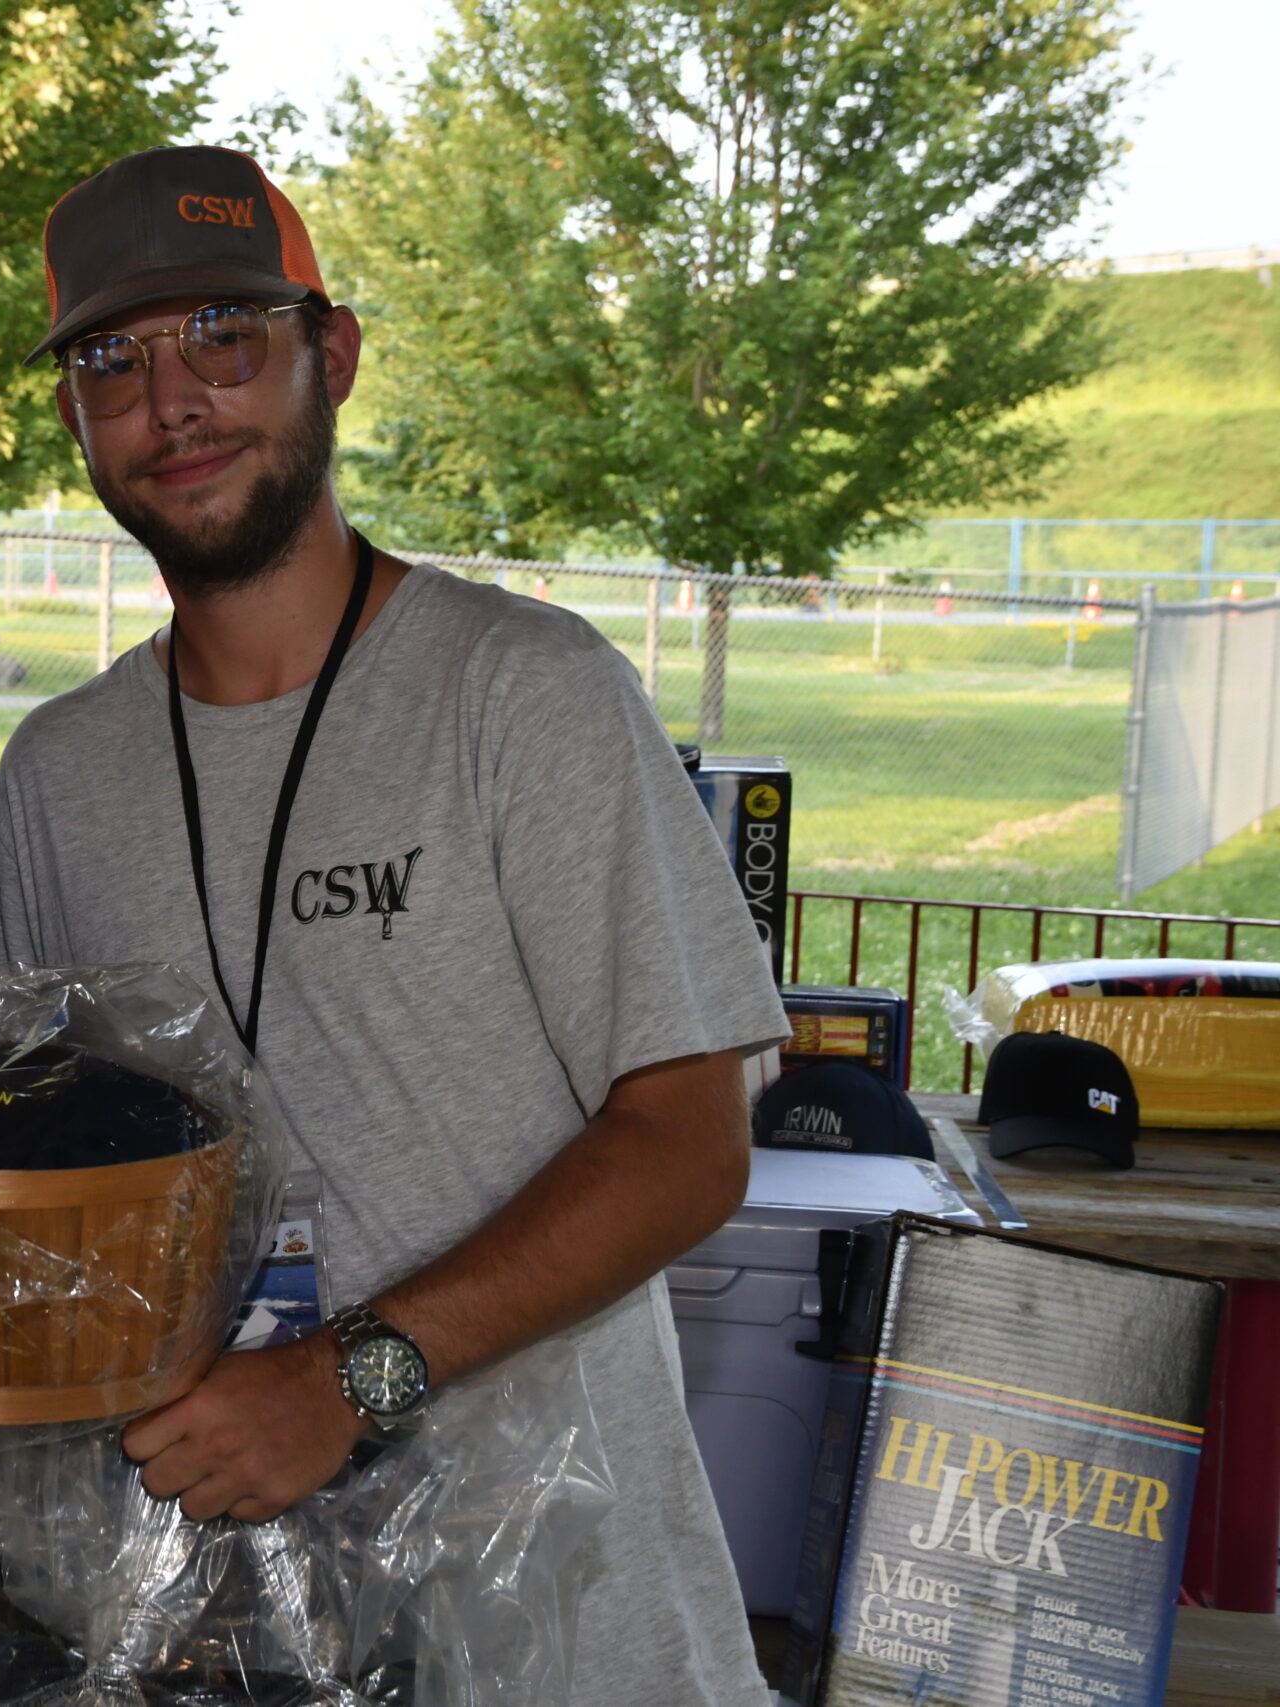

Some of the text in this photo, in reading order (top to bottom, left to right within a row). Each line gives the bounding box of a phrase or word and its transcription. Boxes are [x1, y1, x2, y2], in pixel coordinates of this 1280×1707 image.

[178, 194, 256, 228] CSW
[291, 846, 423, 926] CSW
[745, 823, 777, 912] BODY
[783, 1105, 842, 1134] IRWIN
[1087, 1088, 1119, 1116] CAT
[875, 1416, 1171, 1543] HI POWER
[909, 1464, 1080, 1578] JACK
[864, 1552, 961, 1609] More
[859, 1593, 955, 1646] Great
[1033, 1595, 1078, 1616] DELUXE
[1029, 1625, 1147, 1665] 3000 lbs. Capacity
[1032, 1610, 1128, 1644] HI-POWER JACK
[853, 1625, 952, 1675] Features
[1026, 1649, 1070, 1670] DELUXE
[1021, 1679, 1095, 1706] BALL SCREW
[1023, 1664, 1083, 1689] HI-POWER
